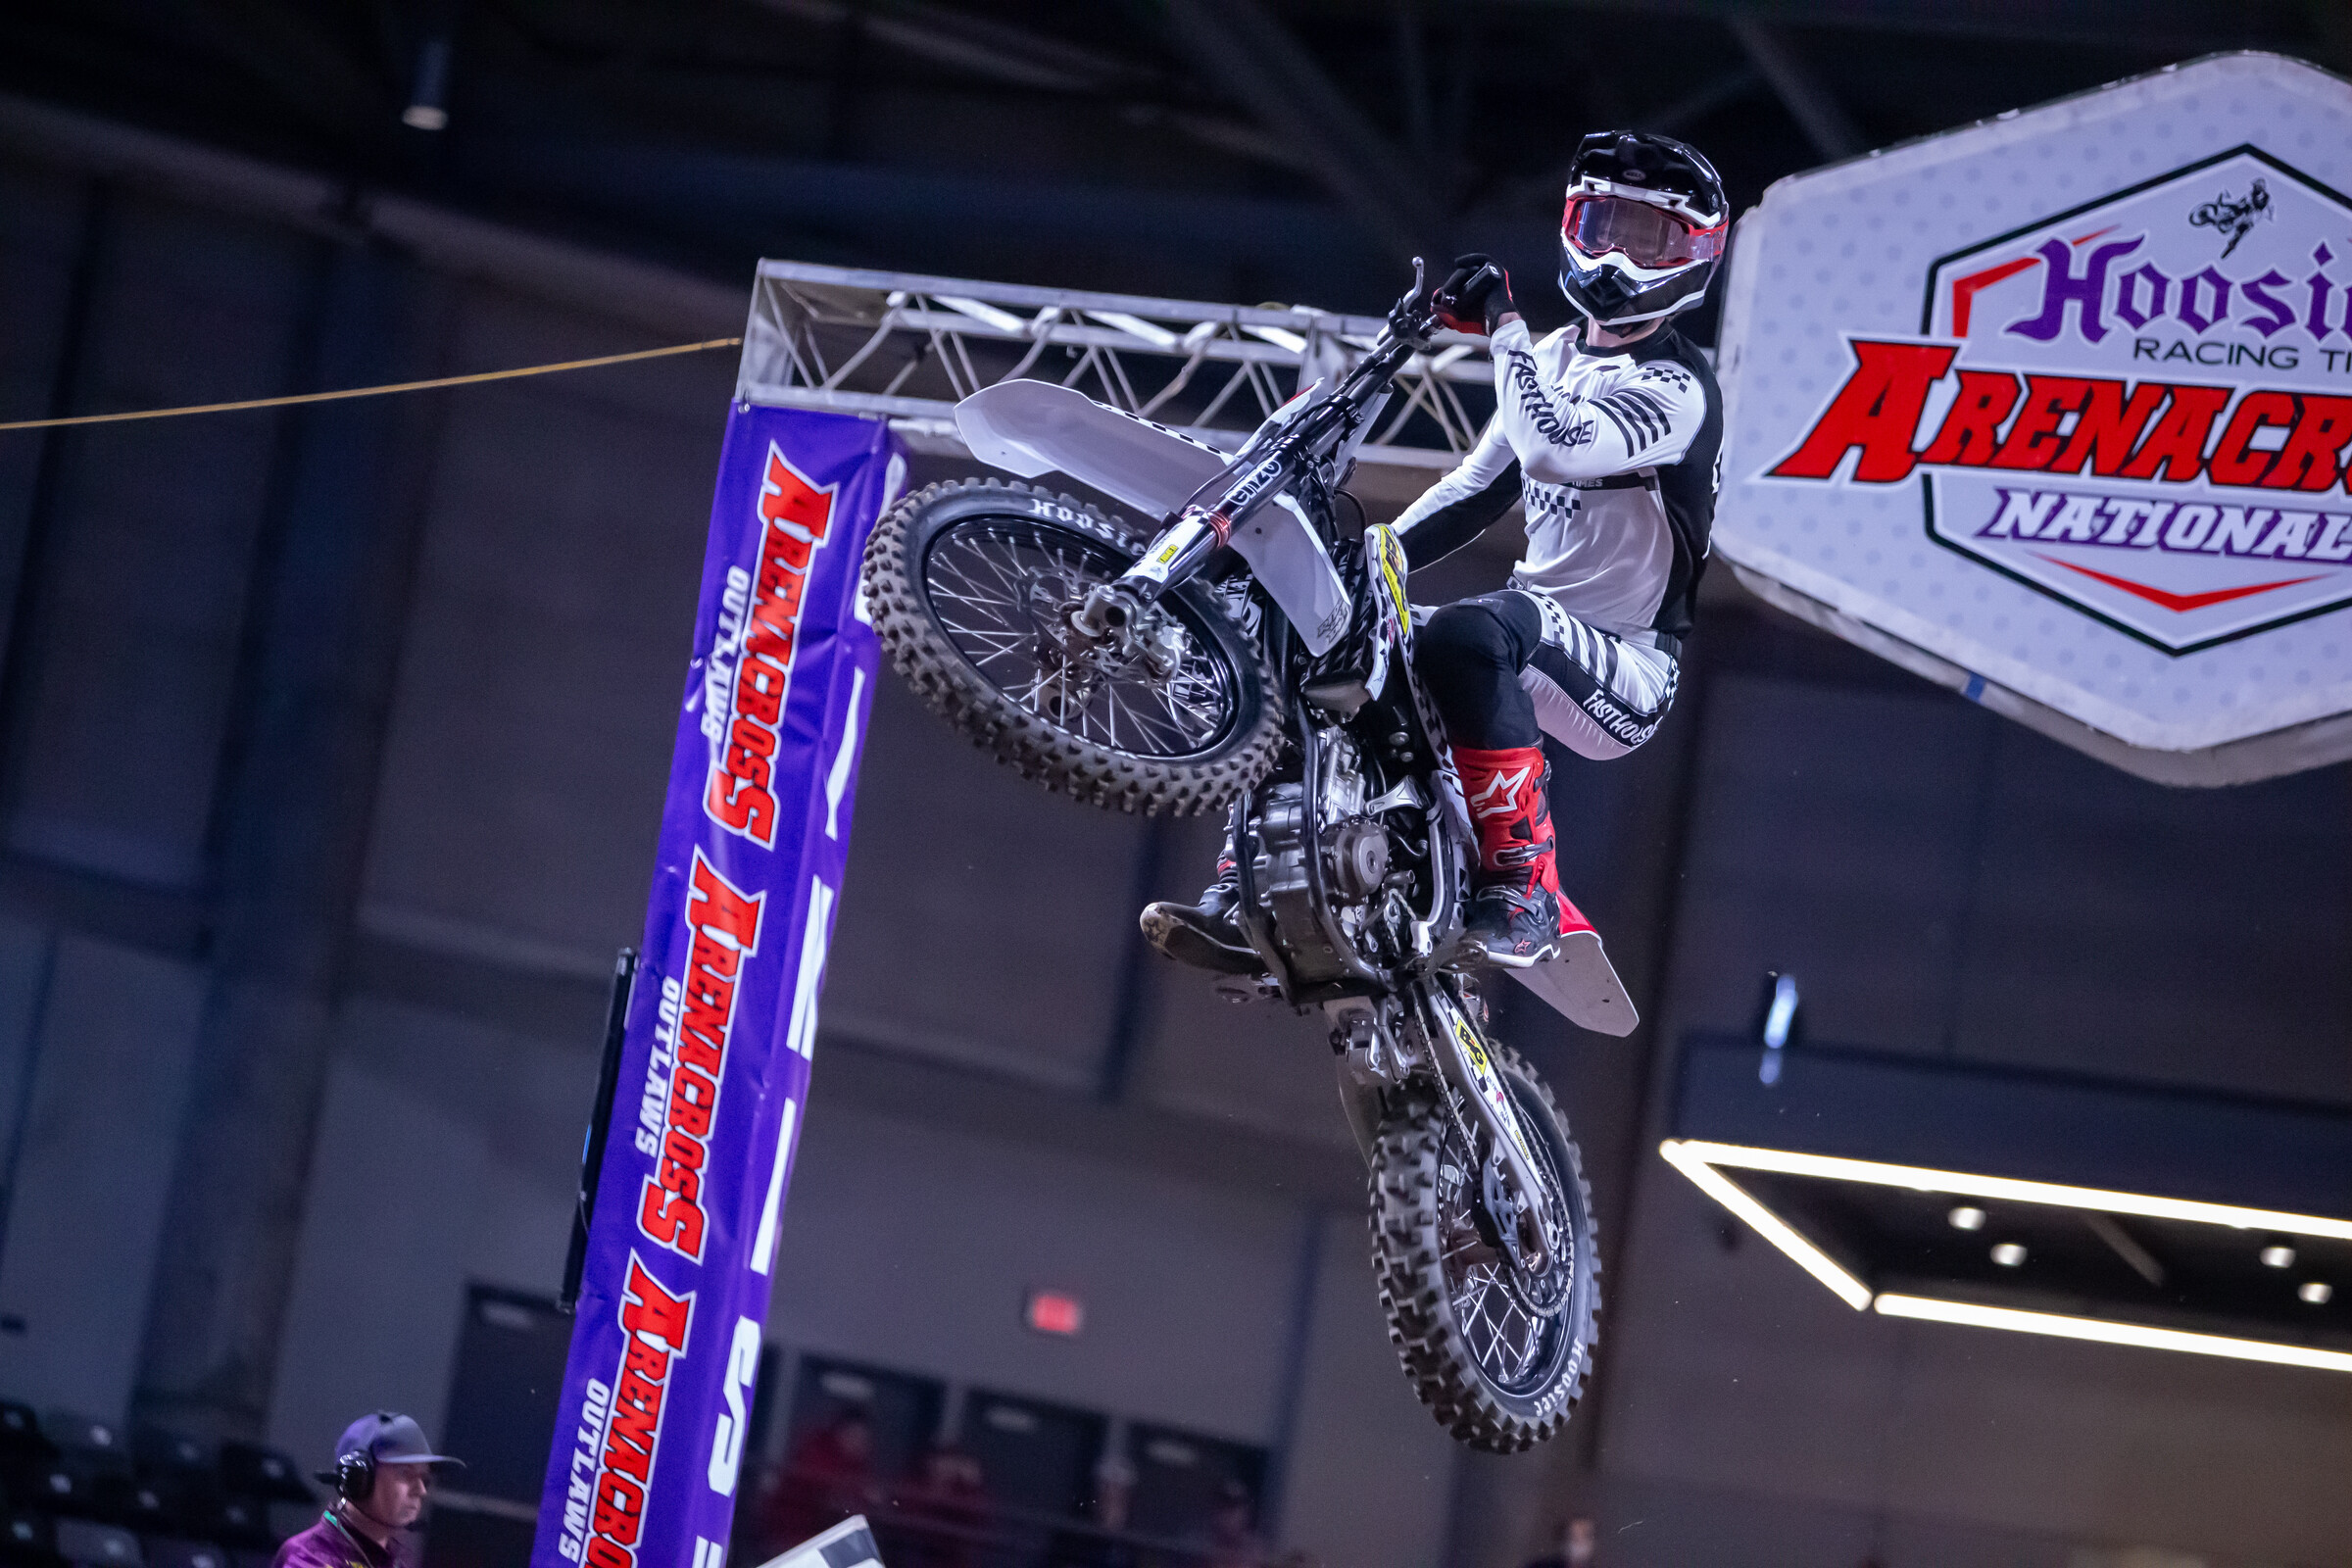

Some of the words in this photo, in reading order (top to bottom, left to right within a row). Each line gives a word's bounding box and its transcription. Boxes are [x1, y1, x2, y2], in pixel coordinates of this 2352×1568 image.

[2005, 234, 2352, 344] Hoosi
[2133, 337, 2299, 370] RACING
[1507, 349, 1594, 447] FASTHOUSE
[1763, 338, 2352, 497] ARENACR
[1027, 496, 1149, 557] Hoosie
[1228, 460, 1282, 506] enzo
[700, 564, 751, 744] OUTLAWS
[703, 438, 840, 852] ARENACROSS
[1582, 688, 1664, 745] FASTHOUS
[634, 975, 681, 1158] OUTLAWS
[636, 843, 767, 1266] ARENACROSS
[558, 1376, 612, 1564] OUTLAWS
